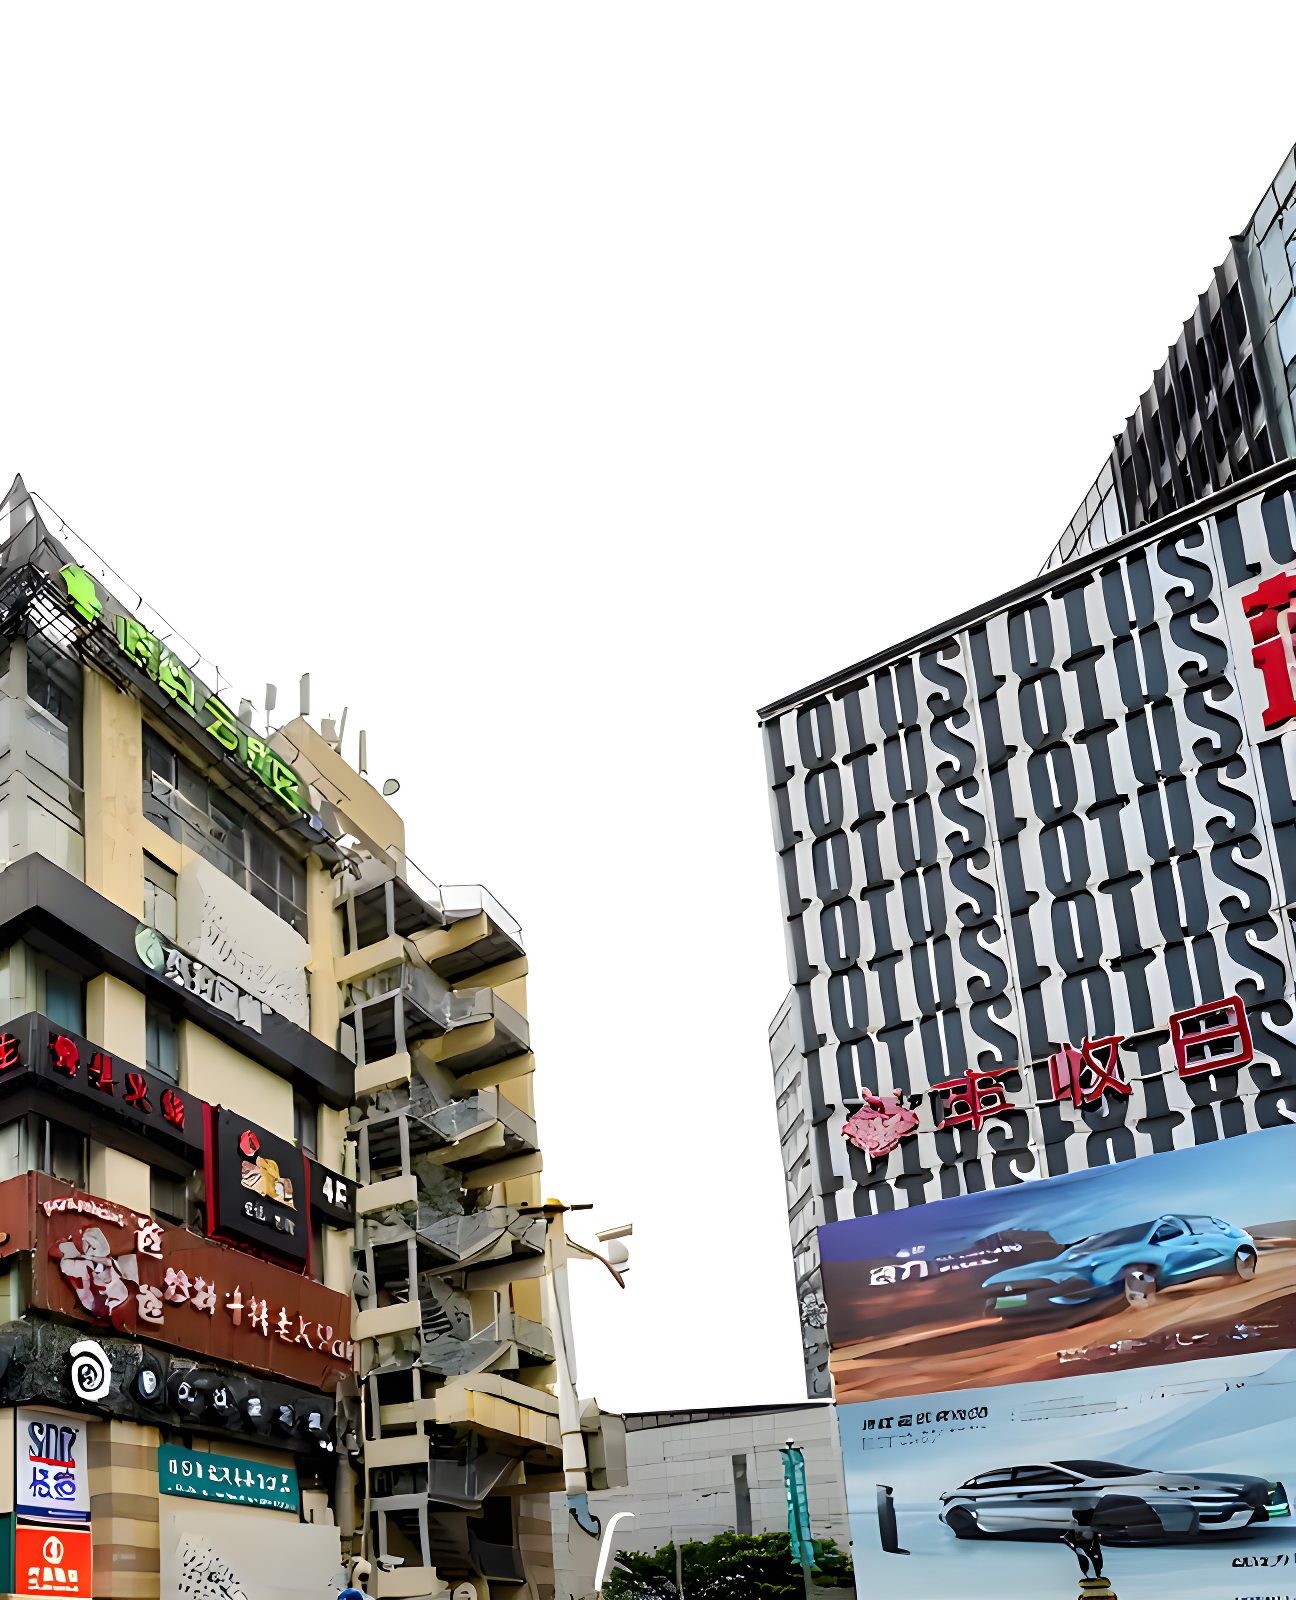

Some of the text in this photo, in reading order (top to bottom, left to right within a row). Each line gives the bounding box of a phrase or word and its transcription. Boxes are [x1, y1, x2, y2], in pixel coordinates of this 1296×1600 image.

[969, 521, 1214, 701] LOTUS
[979, 597, 1228, 776] LOTUS
[764, 641, 968, 787] LOTUS
[772, 706, 977, 854] LOTUS
[989, 673, 1244, 842] LOTUS
[779, 774, 988, 920] LOTUS
[1000, 751, 1257, 917] LOTUS
[788, 846, 997, 986] LOTUS
[1011, 832, 1272, 989] LOTUS
[795, 917, 1008, 1057] LOTUS
[1021, 914, 1287, 1065] LOTUS
